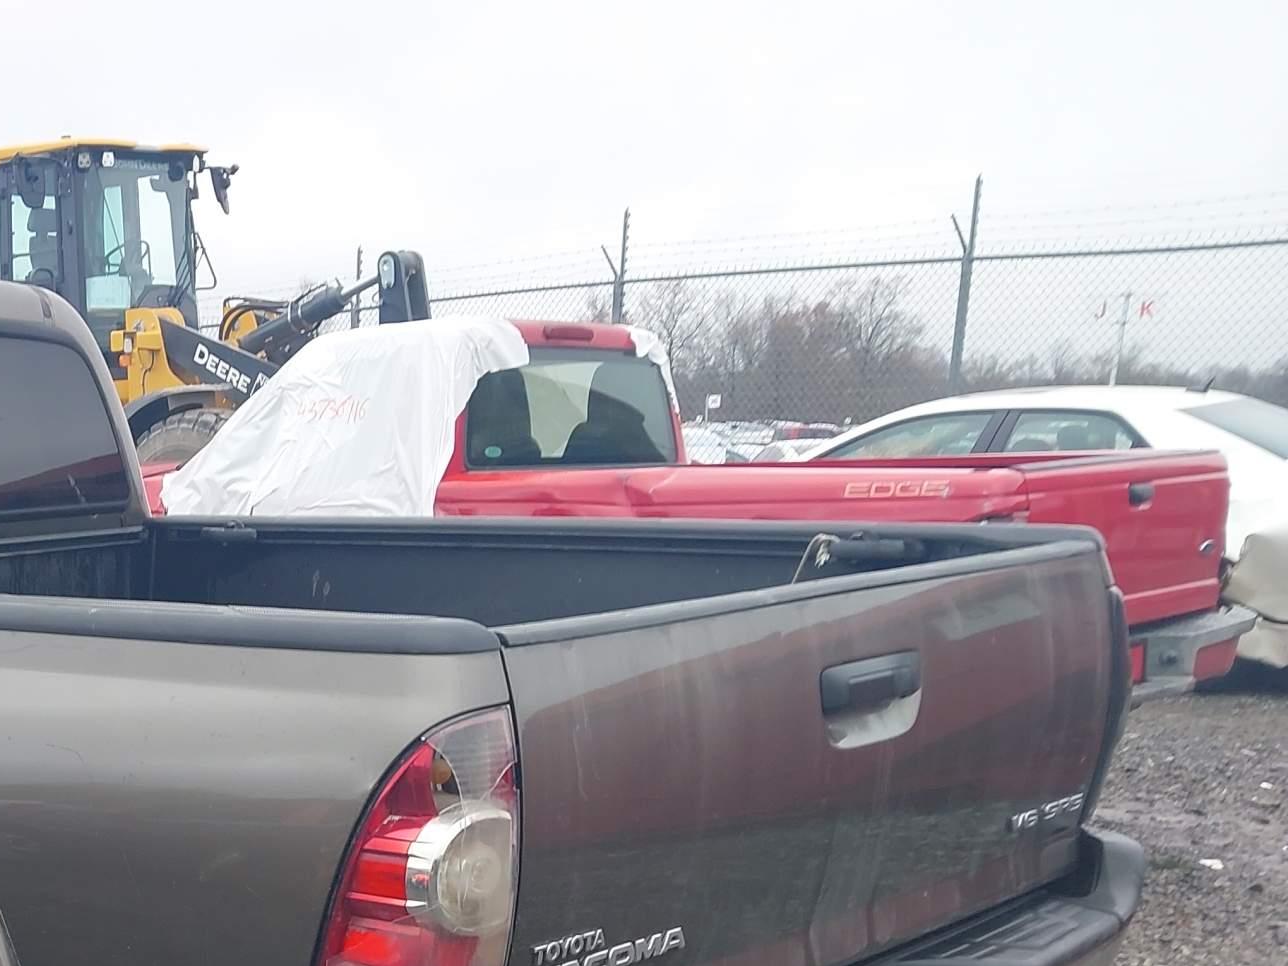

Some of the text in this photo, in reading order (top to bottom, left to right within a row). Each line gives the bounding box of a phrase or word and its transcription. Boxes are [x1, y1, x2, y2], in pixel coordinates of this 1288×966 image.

[193, 343, 252, 394] DEERE
[843, 480, 949, 498] EDGE
[534, 928, 605, 966] TOYOTA
